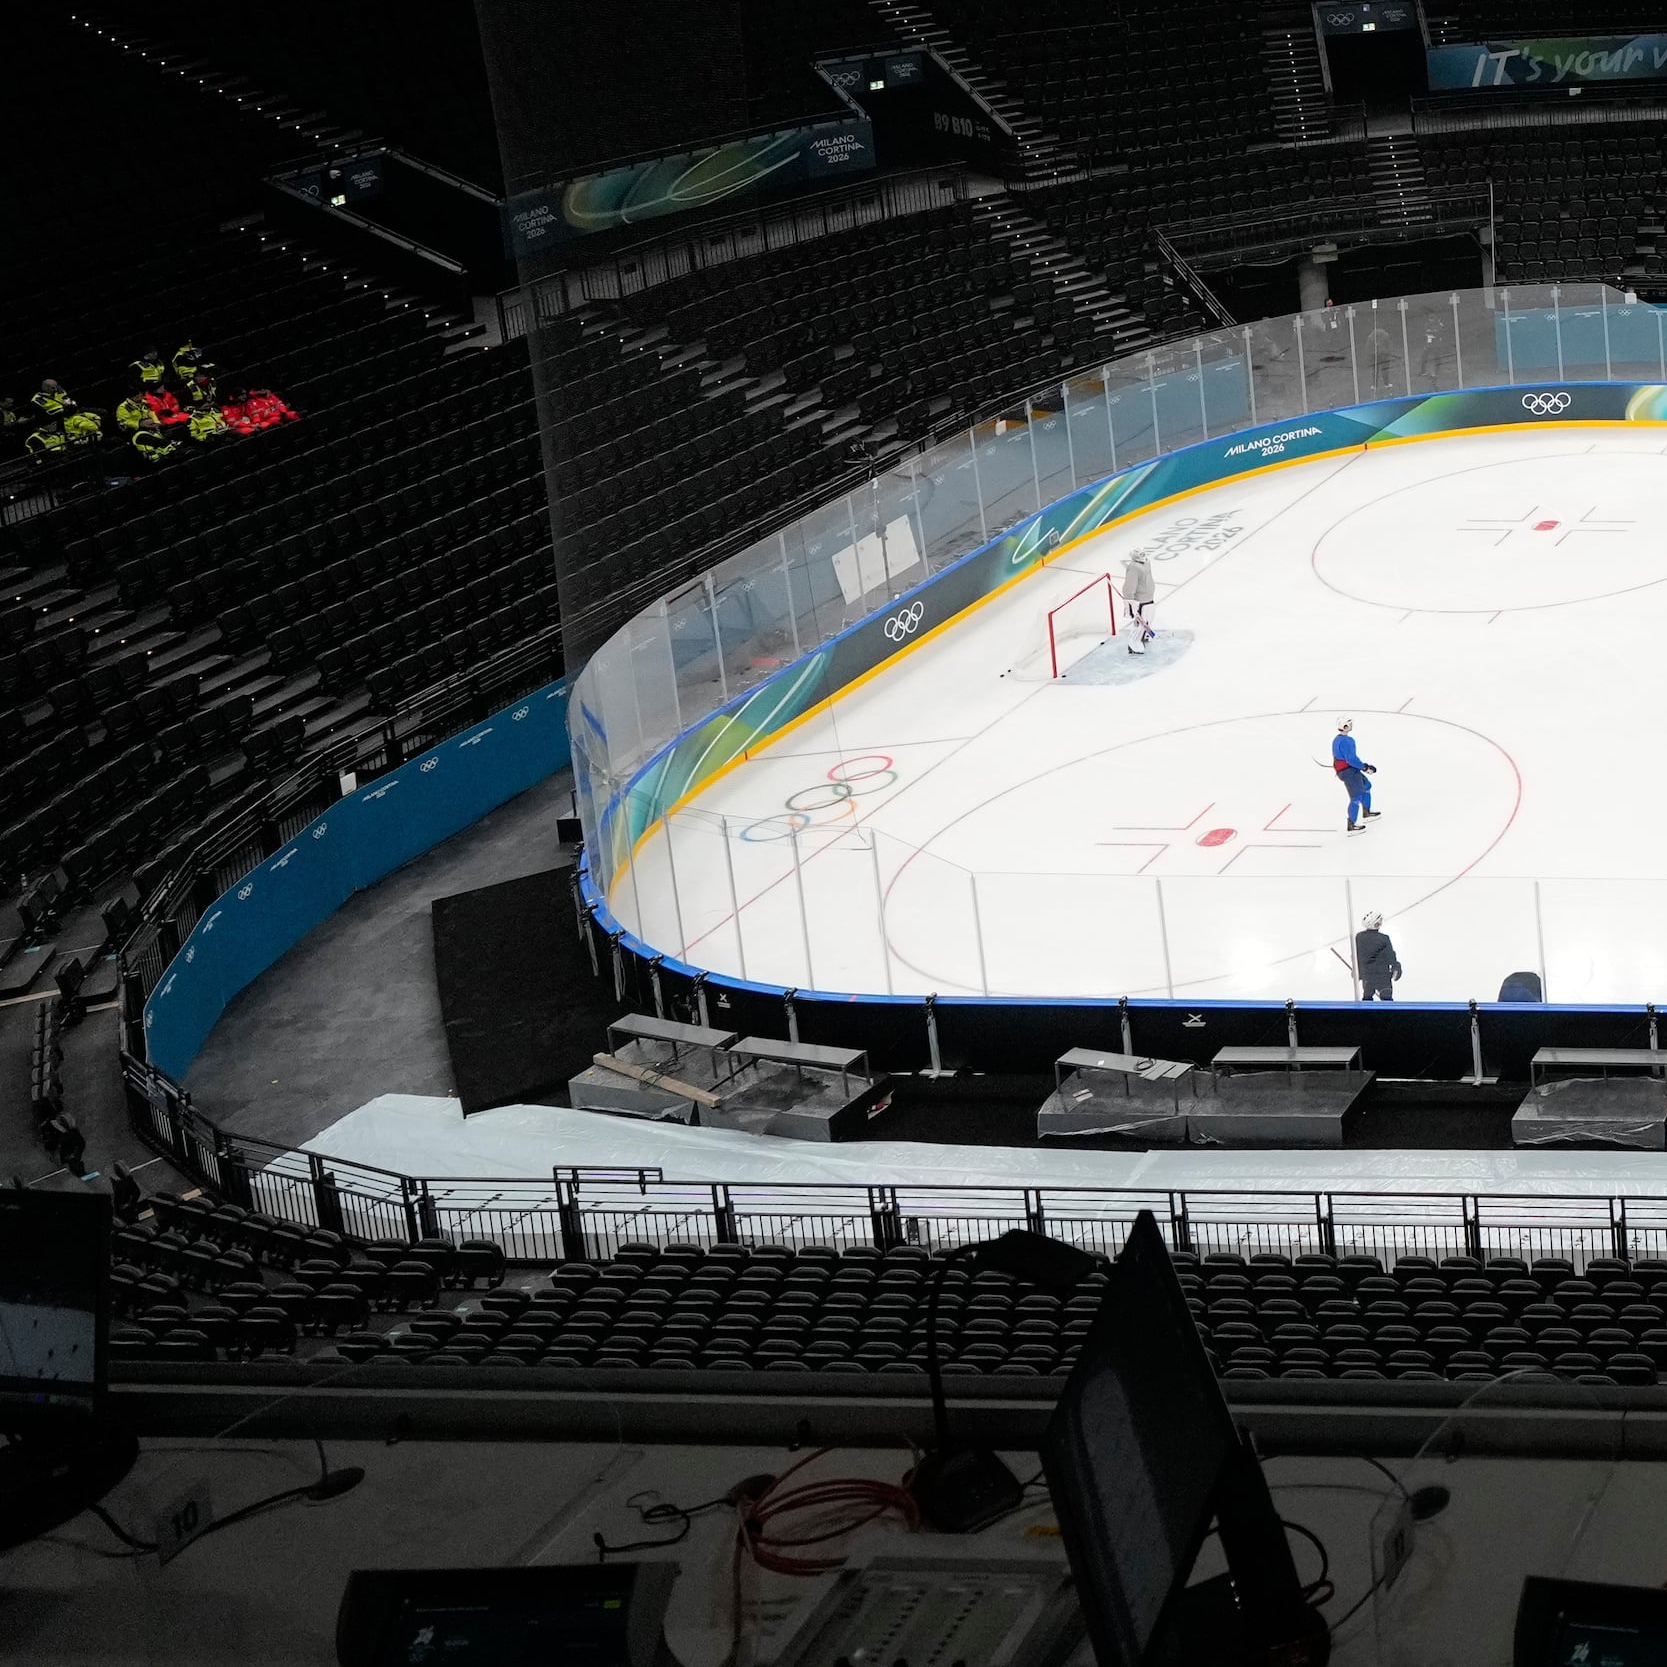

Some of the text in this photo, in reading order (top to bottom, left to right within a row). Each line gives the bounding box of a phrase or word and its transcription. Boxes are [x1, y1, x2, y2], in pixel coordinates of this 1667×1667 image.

[1471, 46, 1545, 88] IT's
[1552, 49, 1645, 84] your
[809, 134, 855, 150] MILANO
[817, 142, 866, 157] CORTINA
[827, 153, 850, 165] 2026
[1223, 426, 1323, 458] MILANO CORTINA
[1261, 443, 1285, 457] 2026
[1153, 509, 1245, 561] CORTINA
